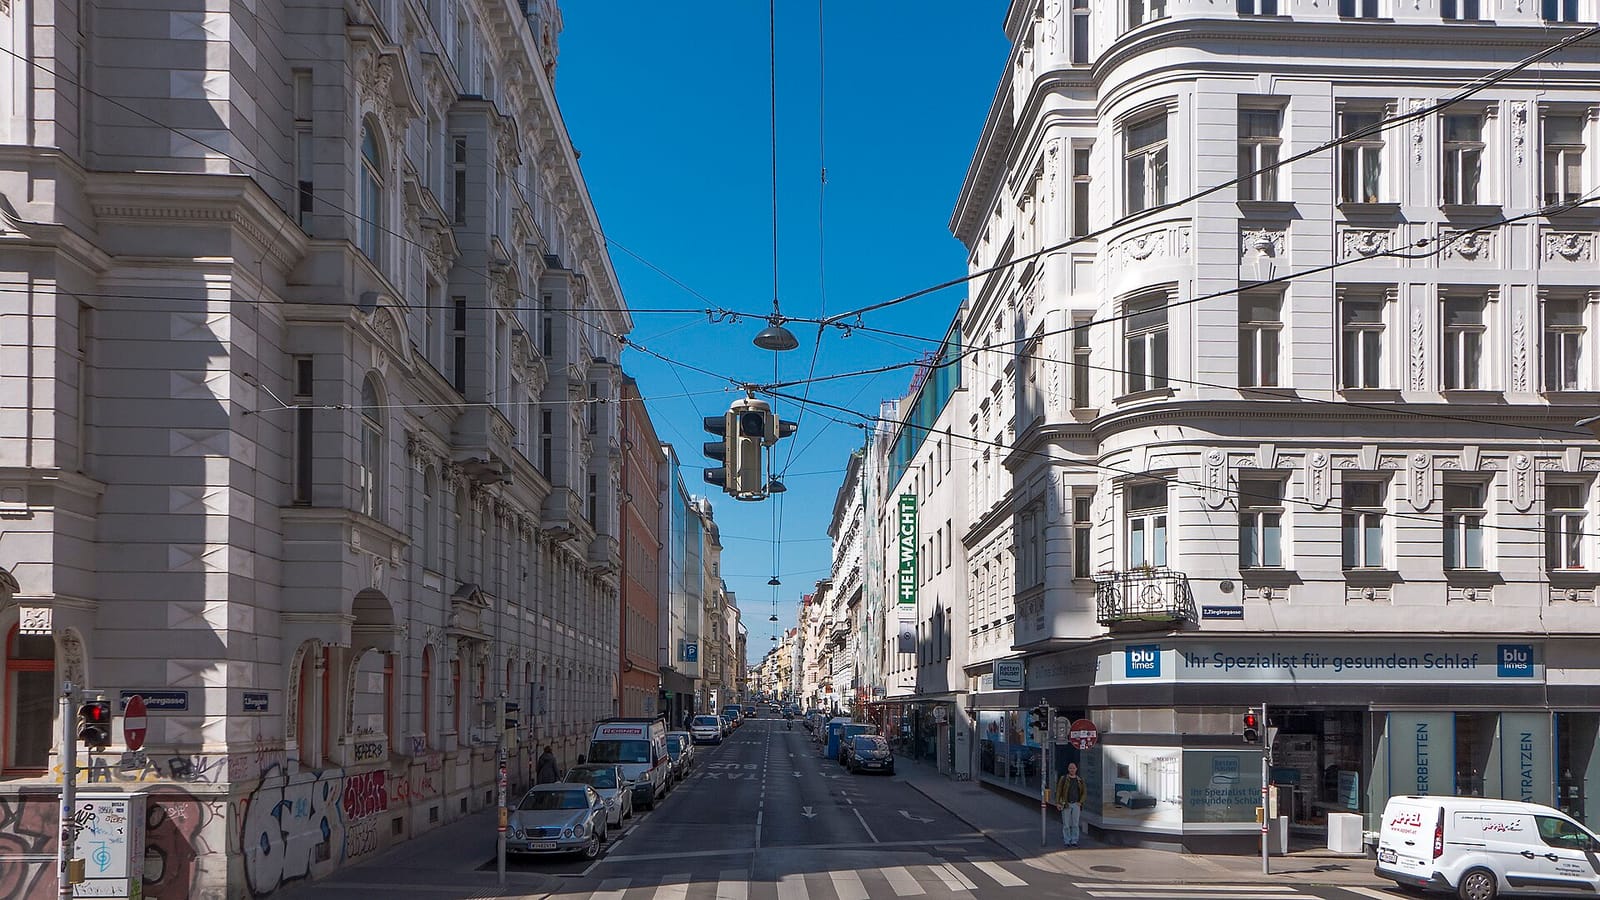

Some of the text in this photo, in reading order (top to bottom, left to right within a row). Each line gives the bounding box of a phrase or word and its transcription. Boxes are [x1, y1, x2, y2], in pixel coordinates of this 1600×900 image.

[1131, 651, 1154, 661] blu
[1503, 648, 1527, 661] blu
[1131, 661, 1154, 669] times
[1185, 652, 1479, 672] Ihr Spezialist für gesunden Schlaf
[1503, 661, 1527, 669] times
[1205, 788, 1246, 798] Spezialist
